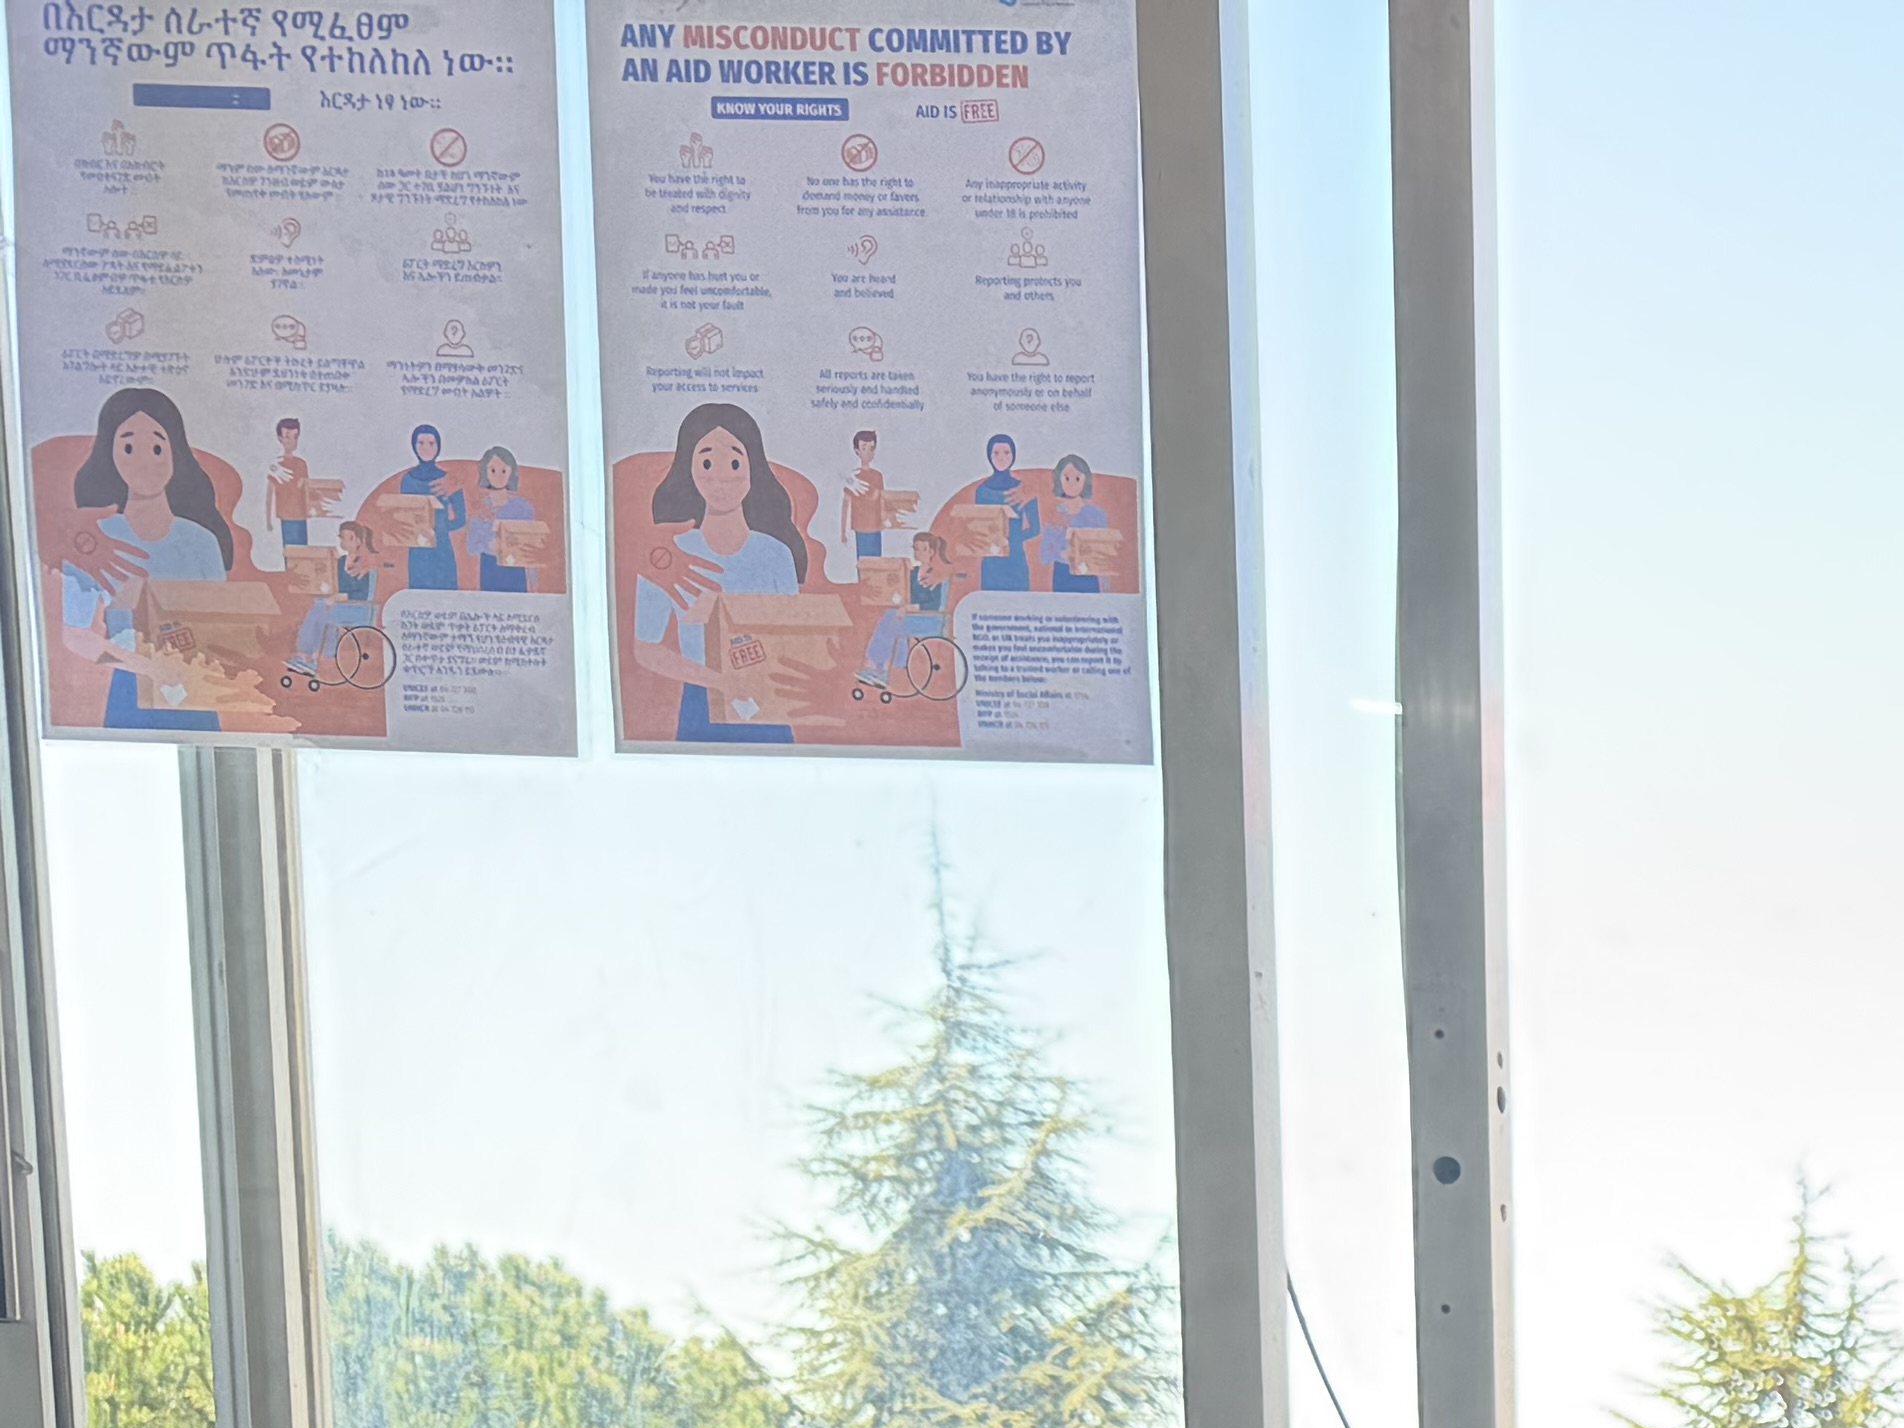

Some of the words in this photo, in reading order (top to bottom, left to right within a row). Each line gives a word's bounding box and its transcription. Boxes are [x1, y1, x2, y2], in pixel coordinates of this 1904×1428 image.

[620, 23, 676, 49] ANY
[682, 25, 861, 52] MISCONDUCT
[867, 28, 1029, 55] COMMITTED
[1035, 30, 1073, 57] BY
[620, 58, 660, 84] AN
[665, 58, 713, 85] AID
[717, 59, 837, 87] WORKER
[842, 61, 869, 87] IS
[875, 62, 1030, 90] FORBIDDEN
[716, 101, 756, 117] KNOW
[757, 102, 793, 118] YOUR
[795, 103, 843, 118] RIGHTS
[915, 104, 941, 120] AID
[943, 105, 958, 121] IS
[963, 104, 997, 121] FREE
[649, 173, 667, 185] You
[668, 175, 691, 185] have
[692, 174, 710, 186] the
[712, 175, 734, 189] right
[736, 176, 746, 186] to
[645, 188, 657, 199] be
[659, 188, 694, 200] treated
[695, 189, 717, 200] with
[718, 189, 752, 202] dignity
[670, 203, 690, 214] and
[975, 274, 1021, 289] Reporting
[1023, 276, 1063, 289] protects
[1065, 278, 1082, 289] you
[1003, 291, 1023, 301] and
[646, 365, 693, 379] Reporting
[693, 366, 712, 378] will
[713, 368, 731, 379] not
[732, 366, 765, 381] impact
[652, 383, 673, 394] your
[676, 382, 706, 393] access
[709, 383, 719, 393] to
[721, 383, 759, 394] services
